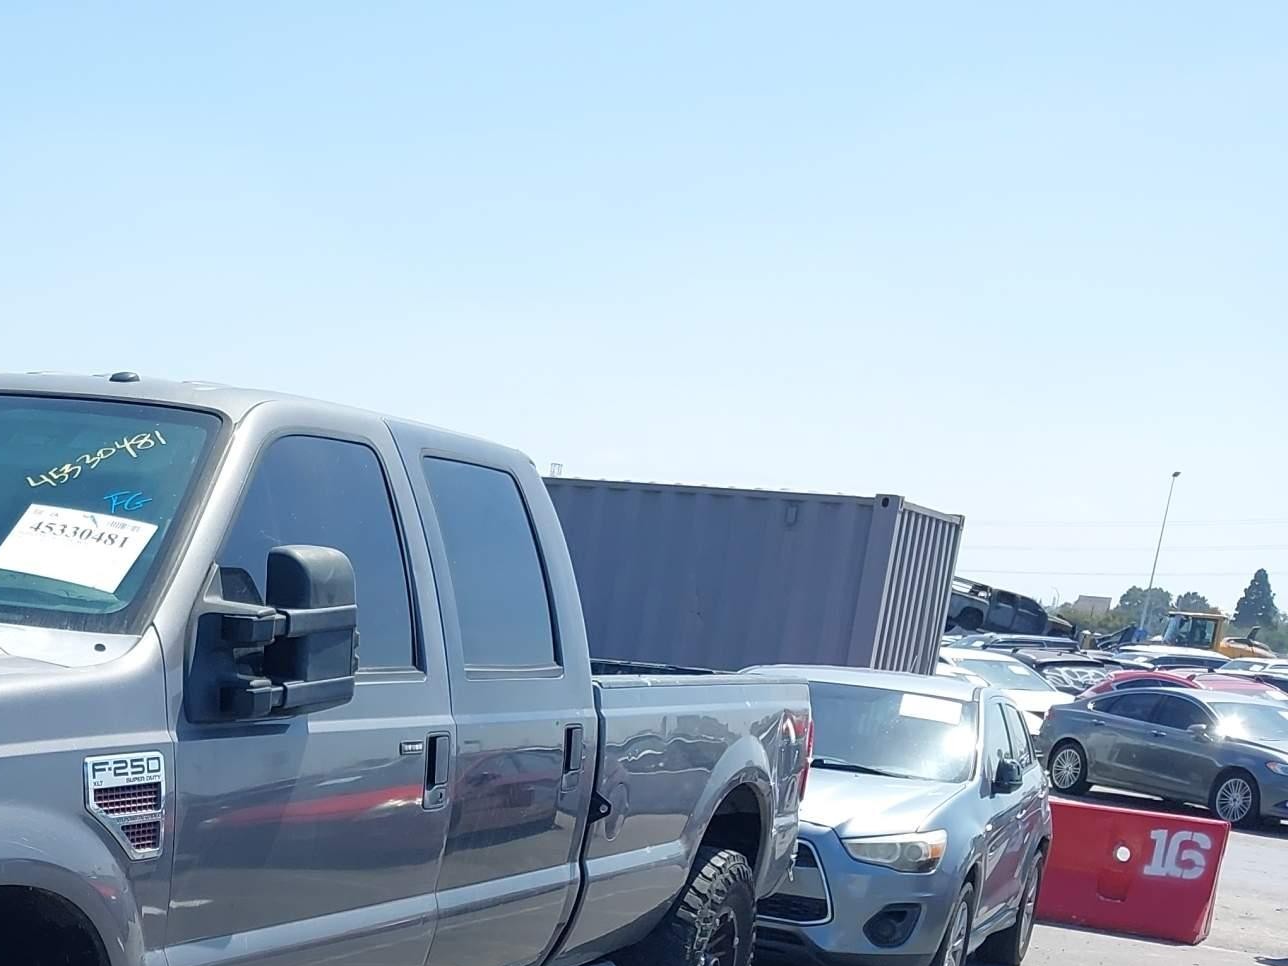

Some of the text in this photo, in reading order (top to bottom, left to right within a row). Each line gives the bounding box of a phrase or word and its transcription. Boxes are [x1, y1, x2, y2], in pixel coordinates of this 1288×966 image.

[26, 430, 167, 487] 45330481
[29, 521, 130, 549] 45330481
[92, 757, 161, 779] F-250
[1143, 829, 1212, 880] 16
